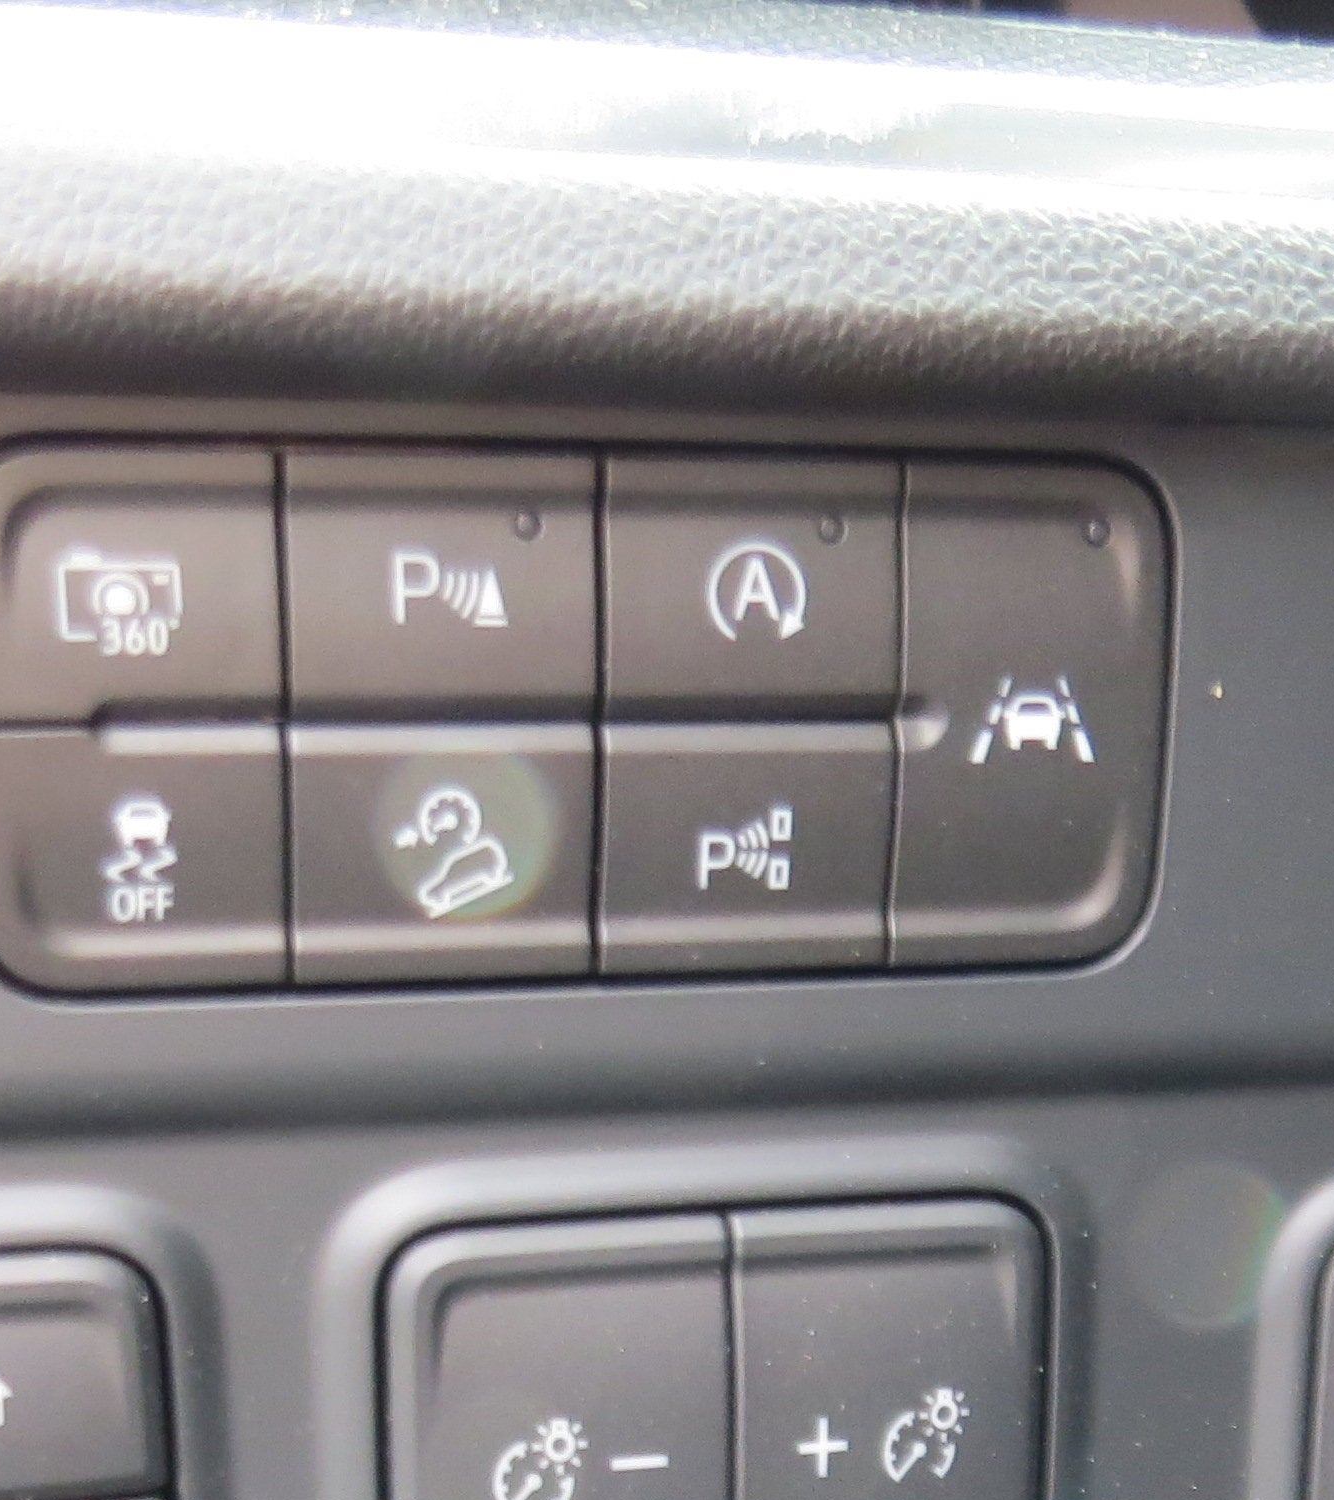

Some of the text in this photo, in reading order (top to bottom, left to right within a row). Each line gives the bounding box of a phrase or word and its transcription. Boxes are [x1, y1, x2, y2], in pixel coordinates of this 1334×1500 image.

[391, 552, 440, 625] P
[734, 556, 780, 621] A
[696, 833, 735, 889] P
[109, 885, 175, 923] OFF
